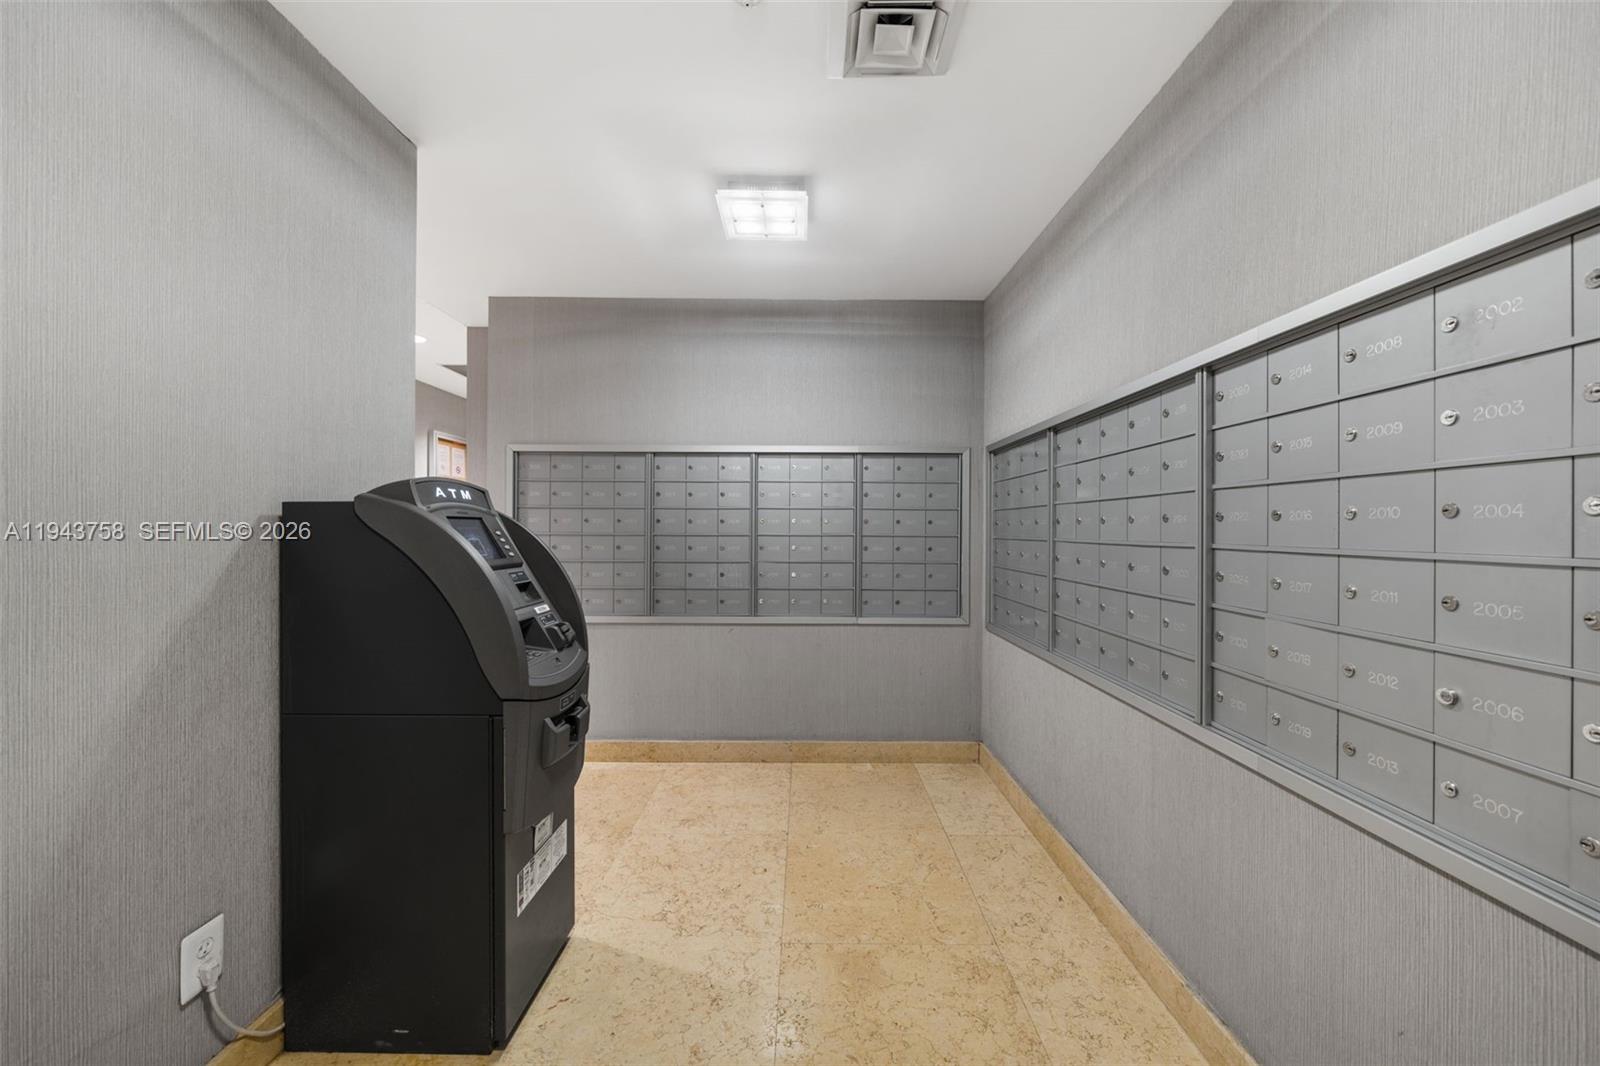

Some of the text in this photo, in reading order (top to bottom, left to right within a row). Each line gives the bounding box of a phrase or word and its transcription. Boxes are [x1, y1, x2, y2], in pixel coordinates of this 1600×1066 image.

[1475, 296, 1524, 323] 2002
[1365, 335, 1403, 357] 2008
[1288, 364, 1312, 379] 2014
[1473, 400, 1525, 421] 2003
[1366, 422, 1403, 440] 2009
[435, 486, 471, 500] ATM
[1288, 509, 1312, 521] 2016
[1367, 506, 1400, 520] 2010
[1473, 504, 1525, 519] 2004
[1288, 581, 1312, 593] 2017
[1370, 590, 1399, 604] 2011
[1473, 601, 1524, 621] 2005
[1367, 671, 1399, 690] 2012
[1472, 697, 1524, 722] 2006
[1367, 752, 1399, 775] 2013
[1472, 794, 1523, 823] 2007
